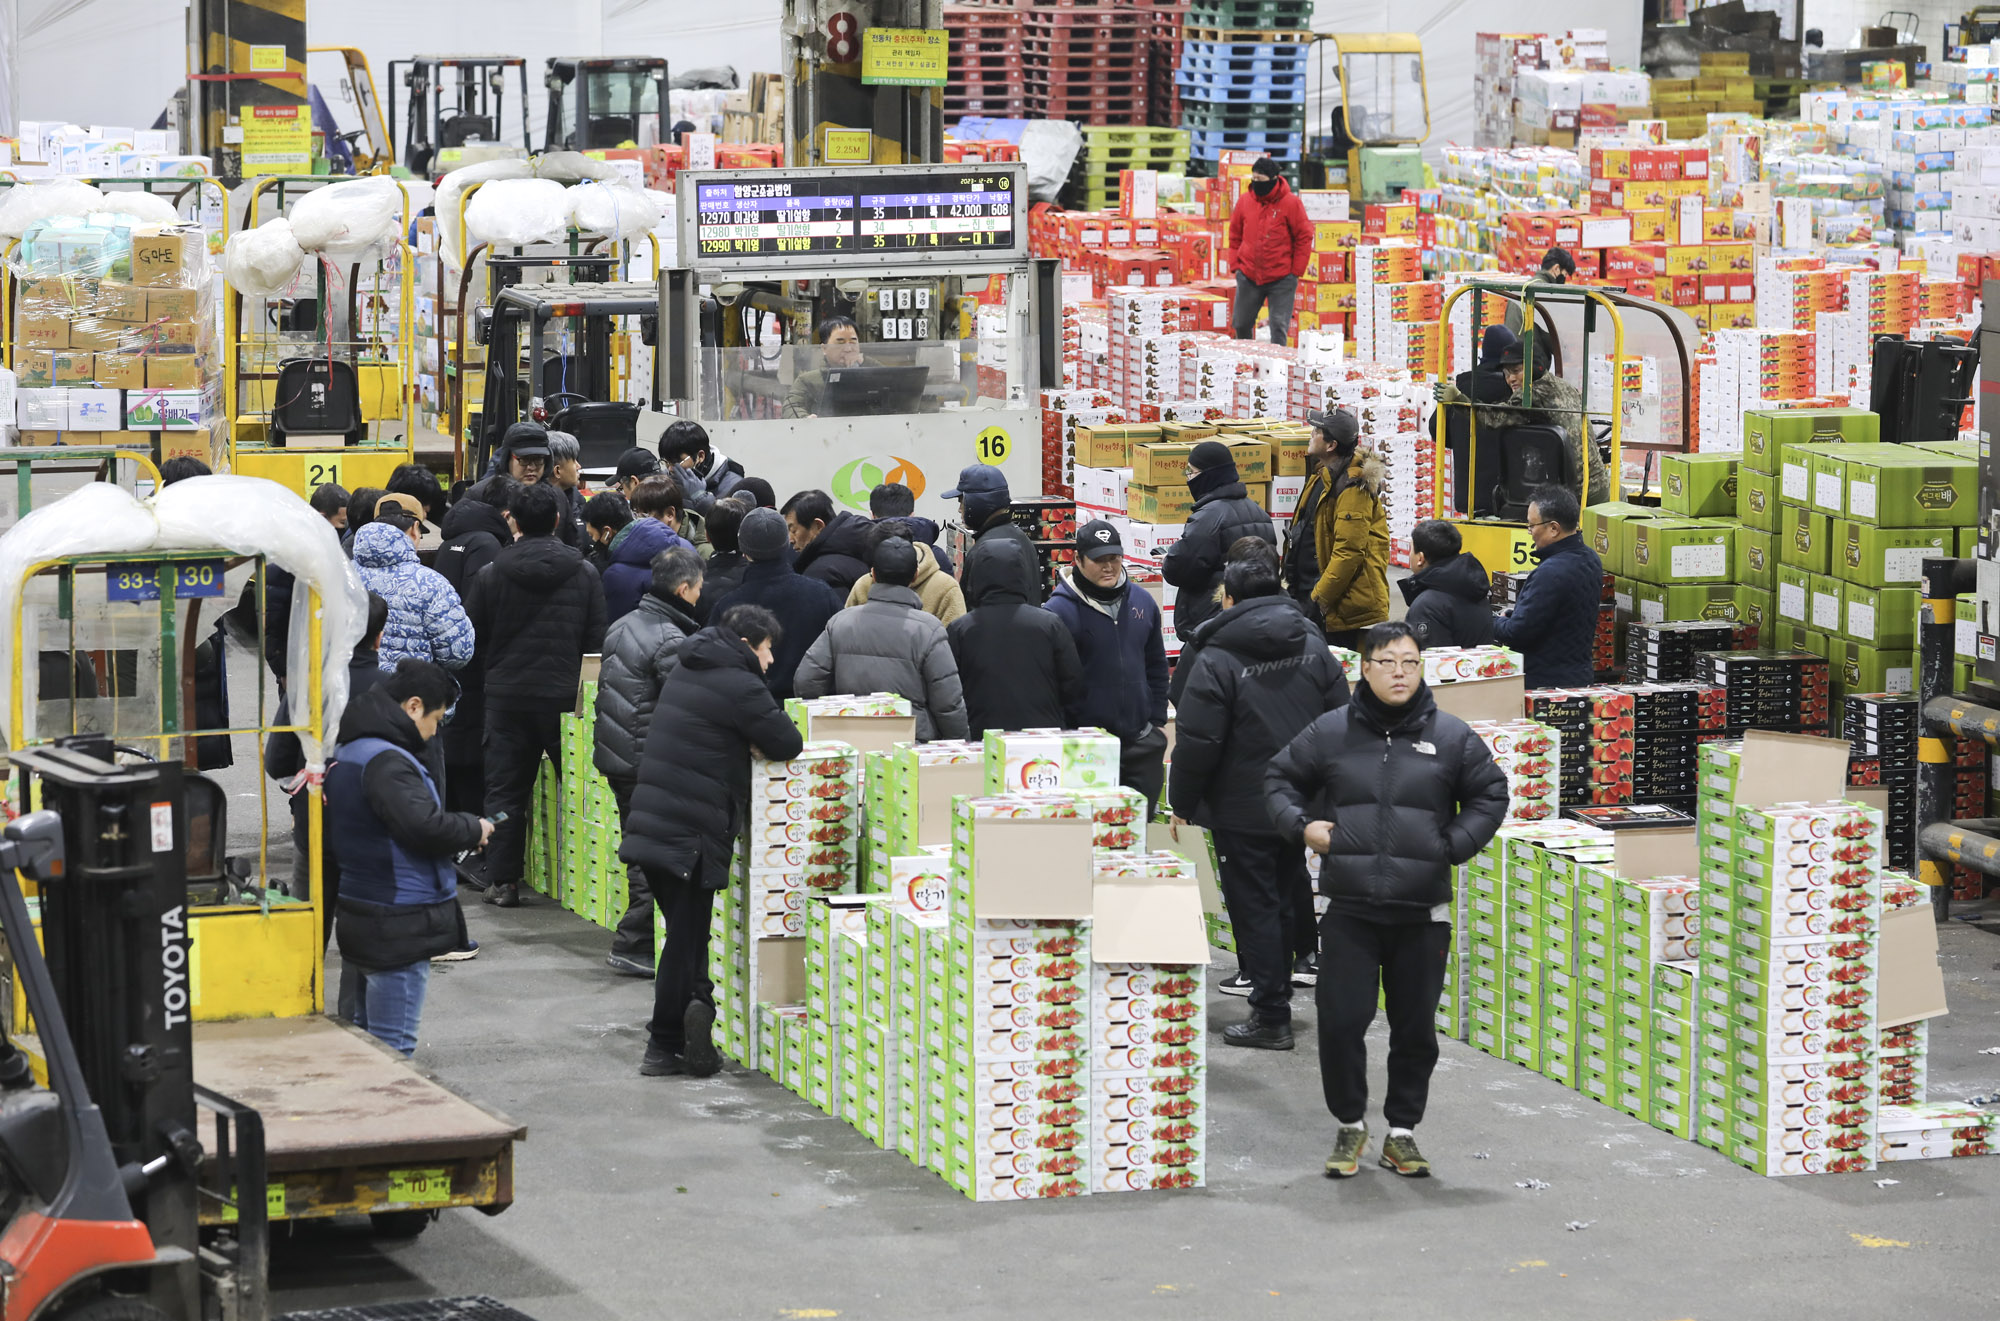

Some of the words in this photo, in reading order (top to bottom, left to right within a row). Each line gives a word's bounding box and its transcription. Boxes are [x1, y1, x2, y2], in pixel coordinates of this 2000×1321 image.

[828, 12, 859, 63] 8
[836, 146, 861, 155] 2.25M
[736, 200, 758, 209] 생산자
[871, 196, 886, 205] 규격
[904, 195, 918, 204] 수량
[701, 212, 730, 224] 12970
[835, 208, 842, 220] 2
[873, 207, 885, 219] 35
[950, 204, 982, 217] 42,000
[991, 203, 1009, 216] 608
[702, 226, 730, 238] 12980
[735, 225, 759, 238] 박기영
[777, 223, 811, 237] 딸기설향
[836, 223, 842, 234] 2
[873, 222, 885, 233] 34
[908, 221, 914, 232] 5
[701, 240, 731, 252] 12990
[835, 237, 842, 248] 2
[873, 234, 885, 247] 35
[906, 234, 917, 246] 17
[979, 435, 1005, 458] 16
[309, 464, 338, 487] 21
[1241, 654, 1316, 678] DYNAFIT
[1029, 774, 1058, 789] 딸기
[916, 888, 945, 907] 딸기
[164, 905, 188, 1031] TOYOTA
